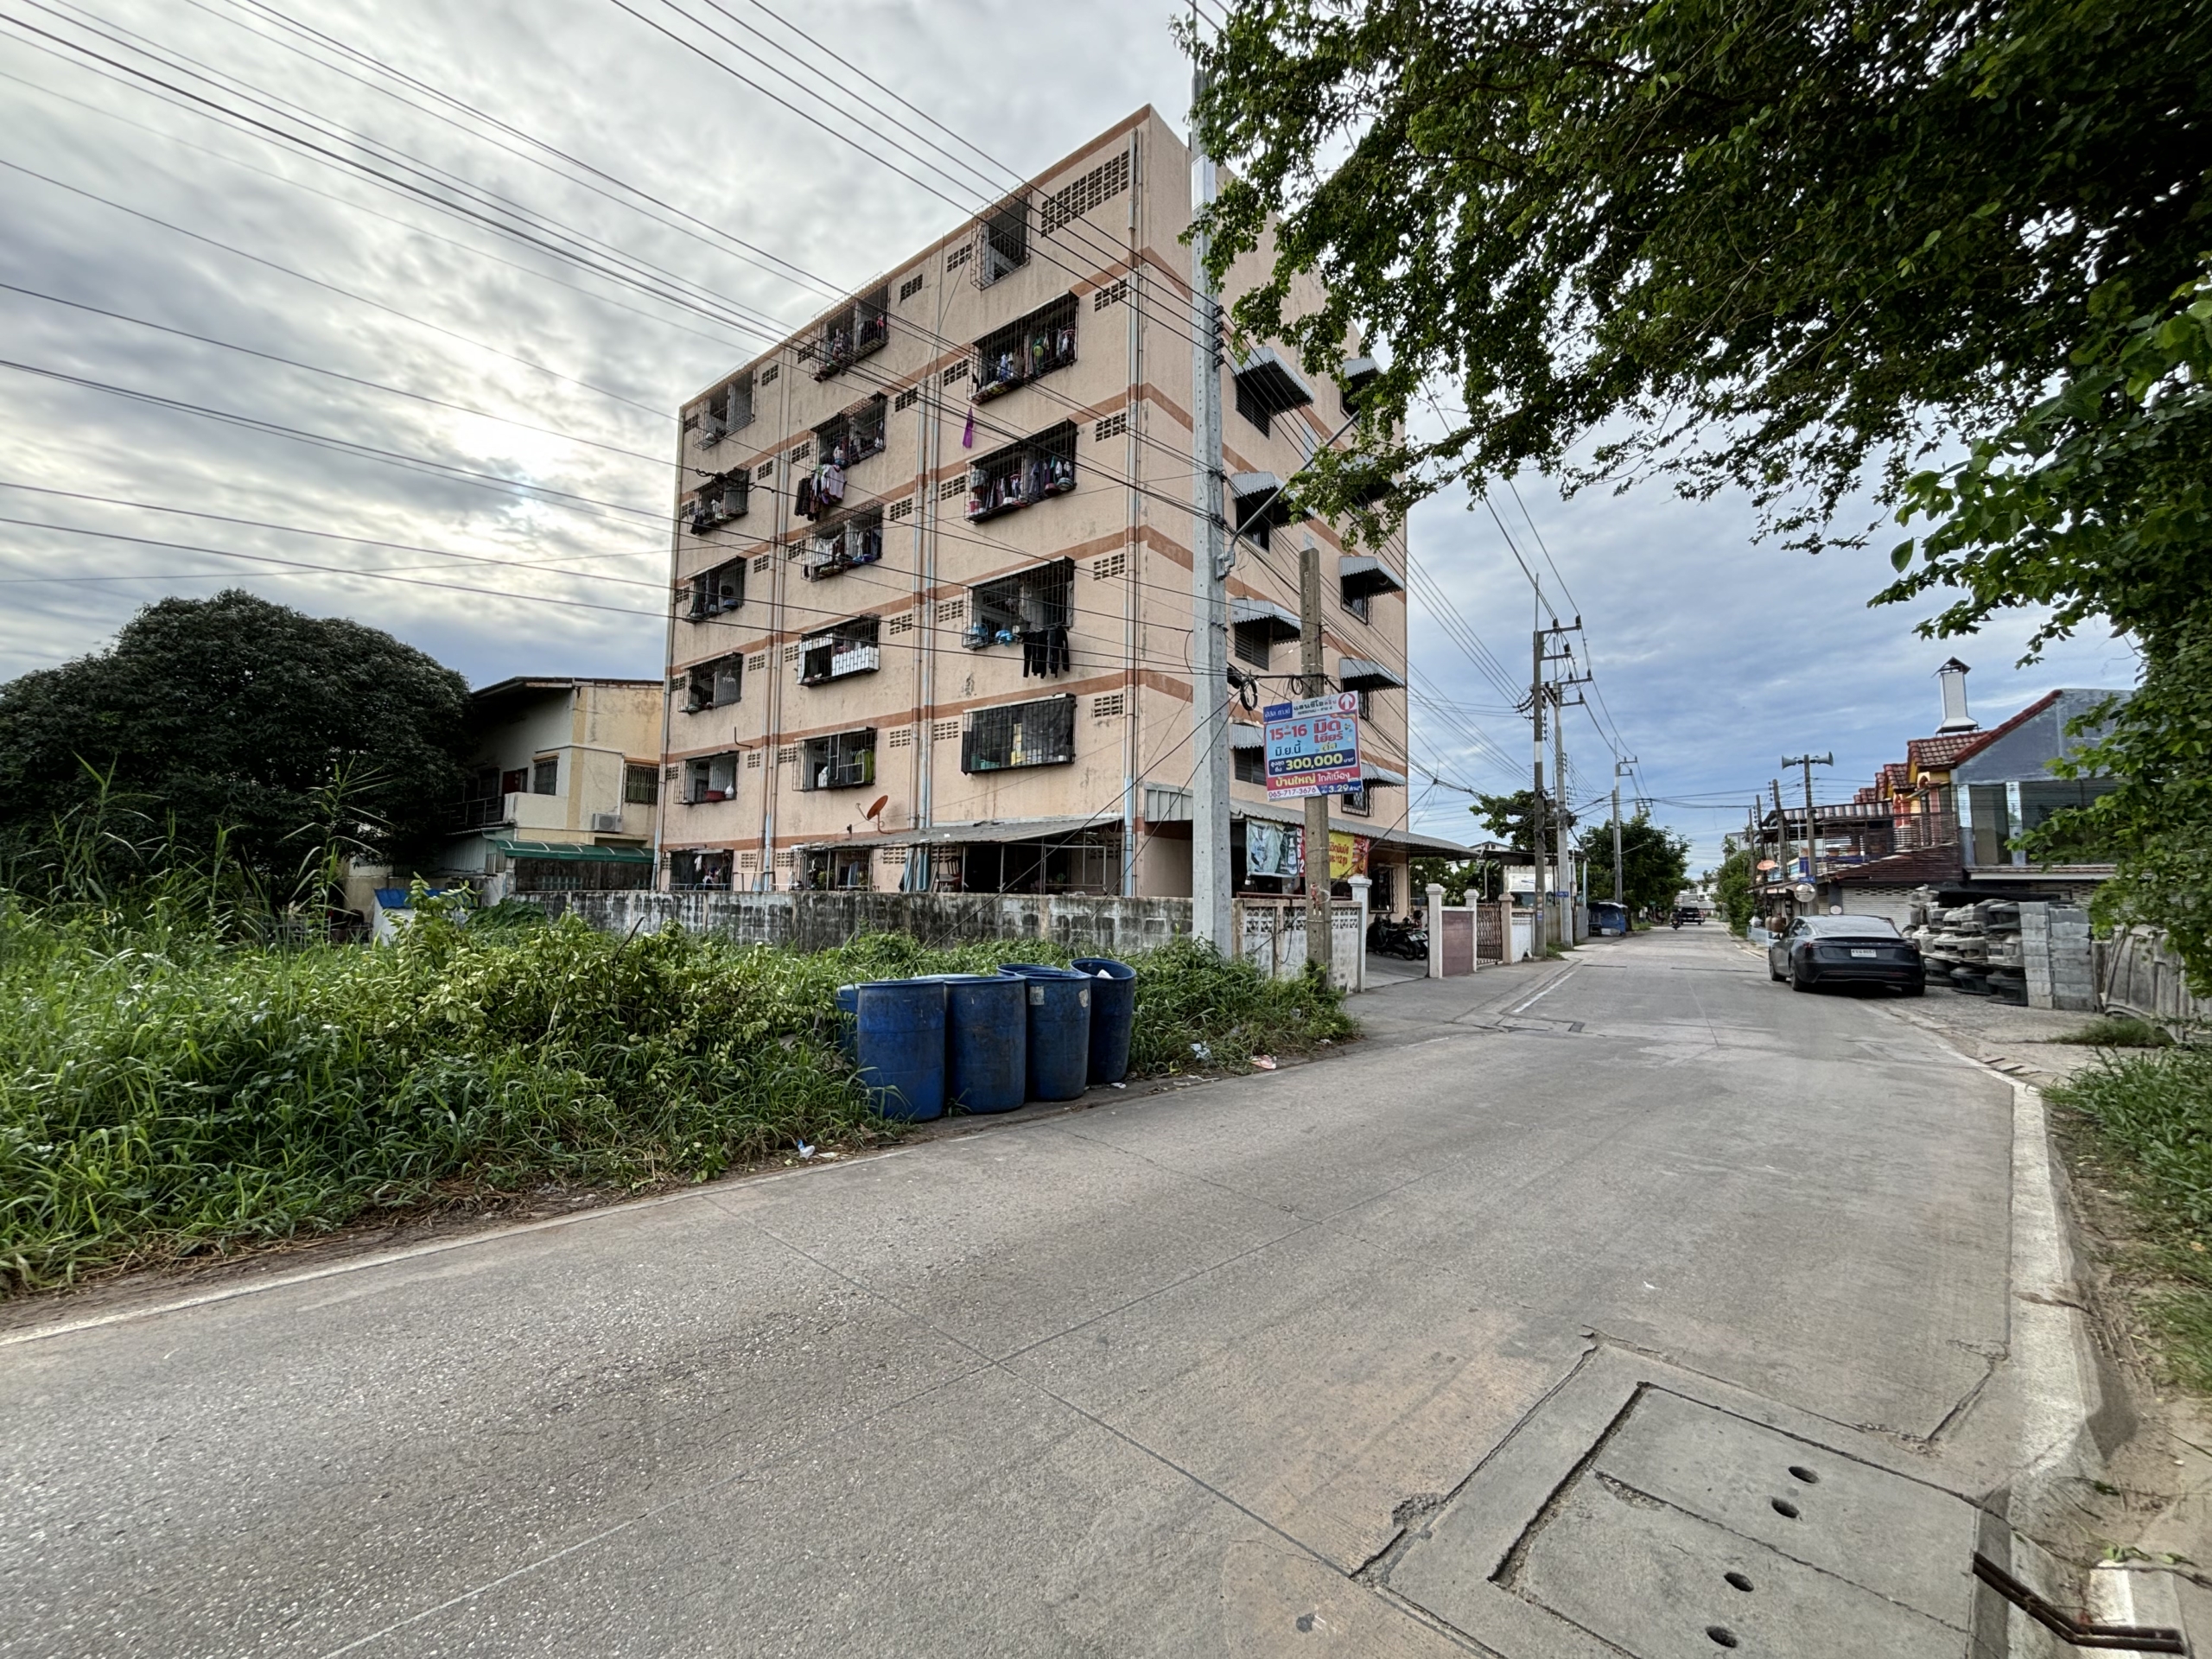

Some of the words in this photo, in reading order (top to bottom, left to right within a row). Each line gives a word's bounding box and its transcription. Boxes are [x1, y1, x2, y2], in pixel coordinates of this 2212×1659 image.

[1269, 724, 1308, 741] 15-16
[1313, 718, 1342, 734] มิด
[1275, 740, 1302, 757] มิ.ย.นี้
[1286, 753, 1344, 771] 300,000
[1275, 772, 1316, 787] บ้านใหญ่
[1268, 786, 1317, 798] 065-717-3676
